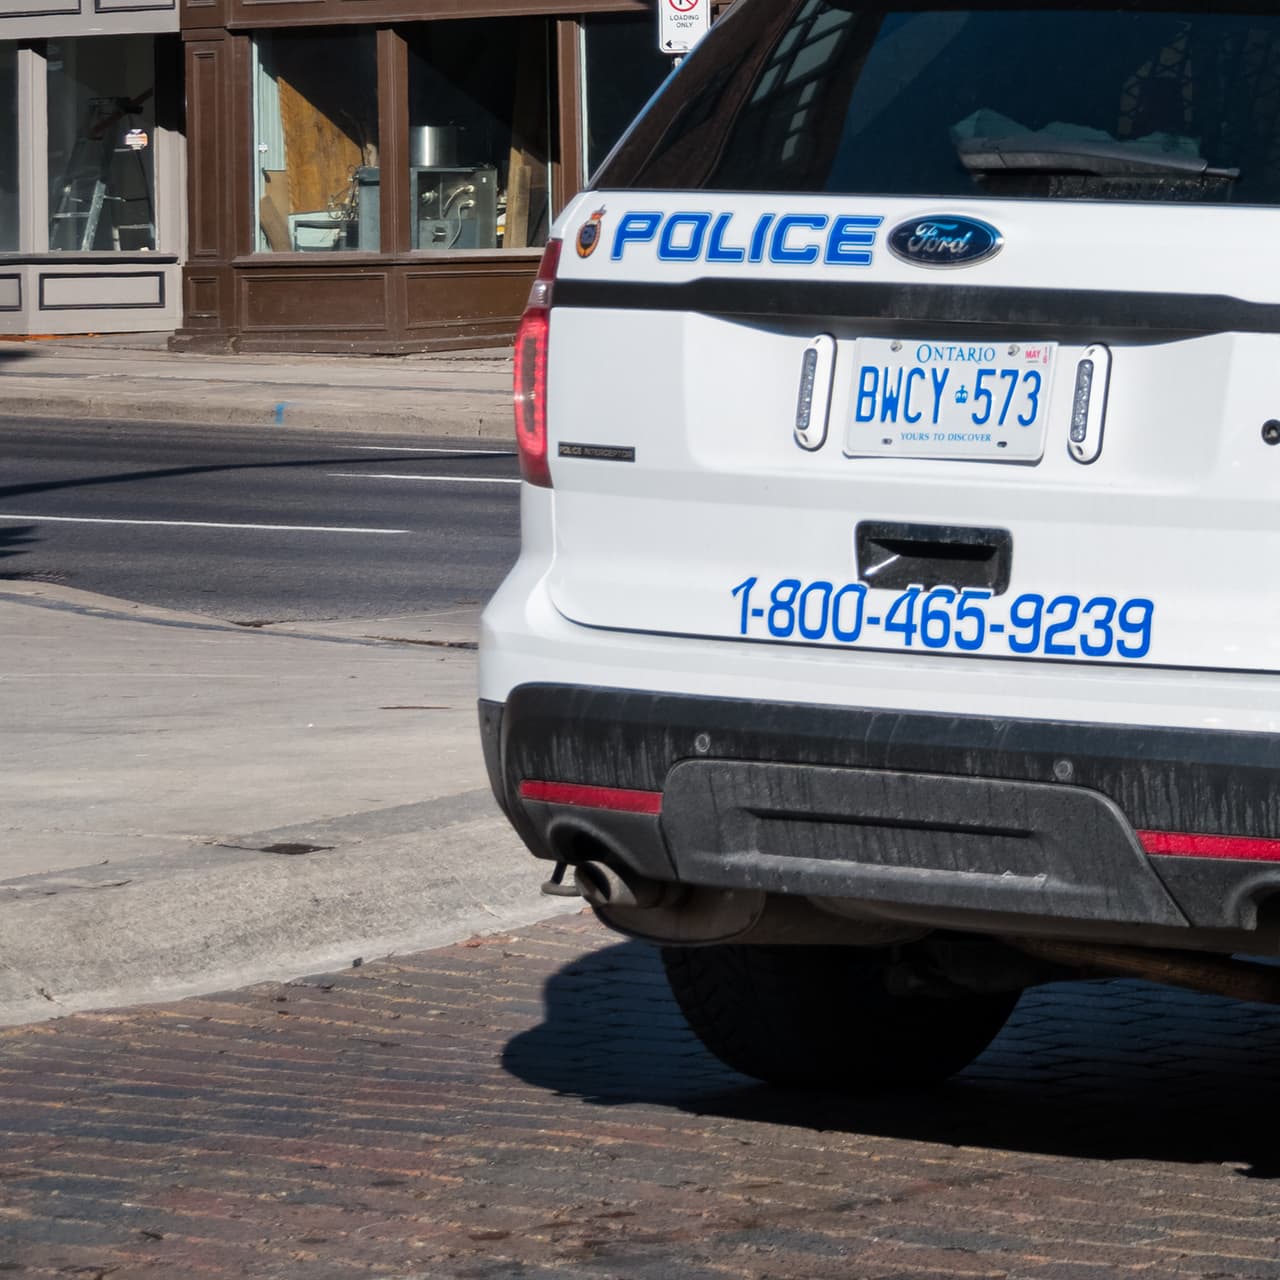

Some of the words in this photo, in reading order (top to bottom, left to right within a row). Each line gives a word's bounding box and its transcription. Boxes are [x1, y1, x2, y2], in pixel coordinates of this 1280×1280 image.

[669, 14, 700, 22] LOADING
[611, 211, 884, 266] POLICE
[907, 221, 973, 254] Ford
[916, 343, 996, 364] ONTARIO
[855, 365, 950, 425] BWCY
[971, 368, 1042, 427] 573
[900, 432, 930, 441] YOURS
[933, 432, 945, 441] TO
[947, 432, 992, 443] DISCOVER
[731, 573, 1155, 659] 1-800-465-9239
